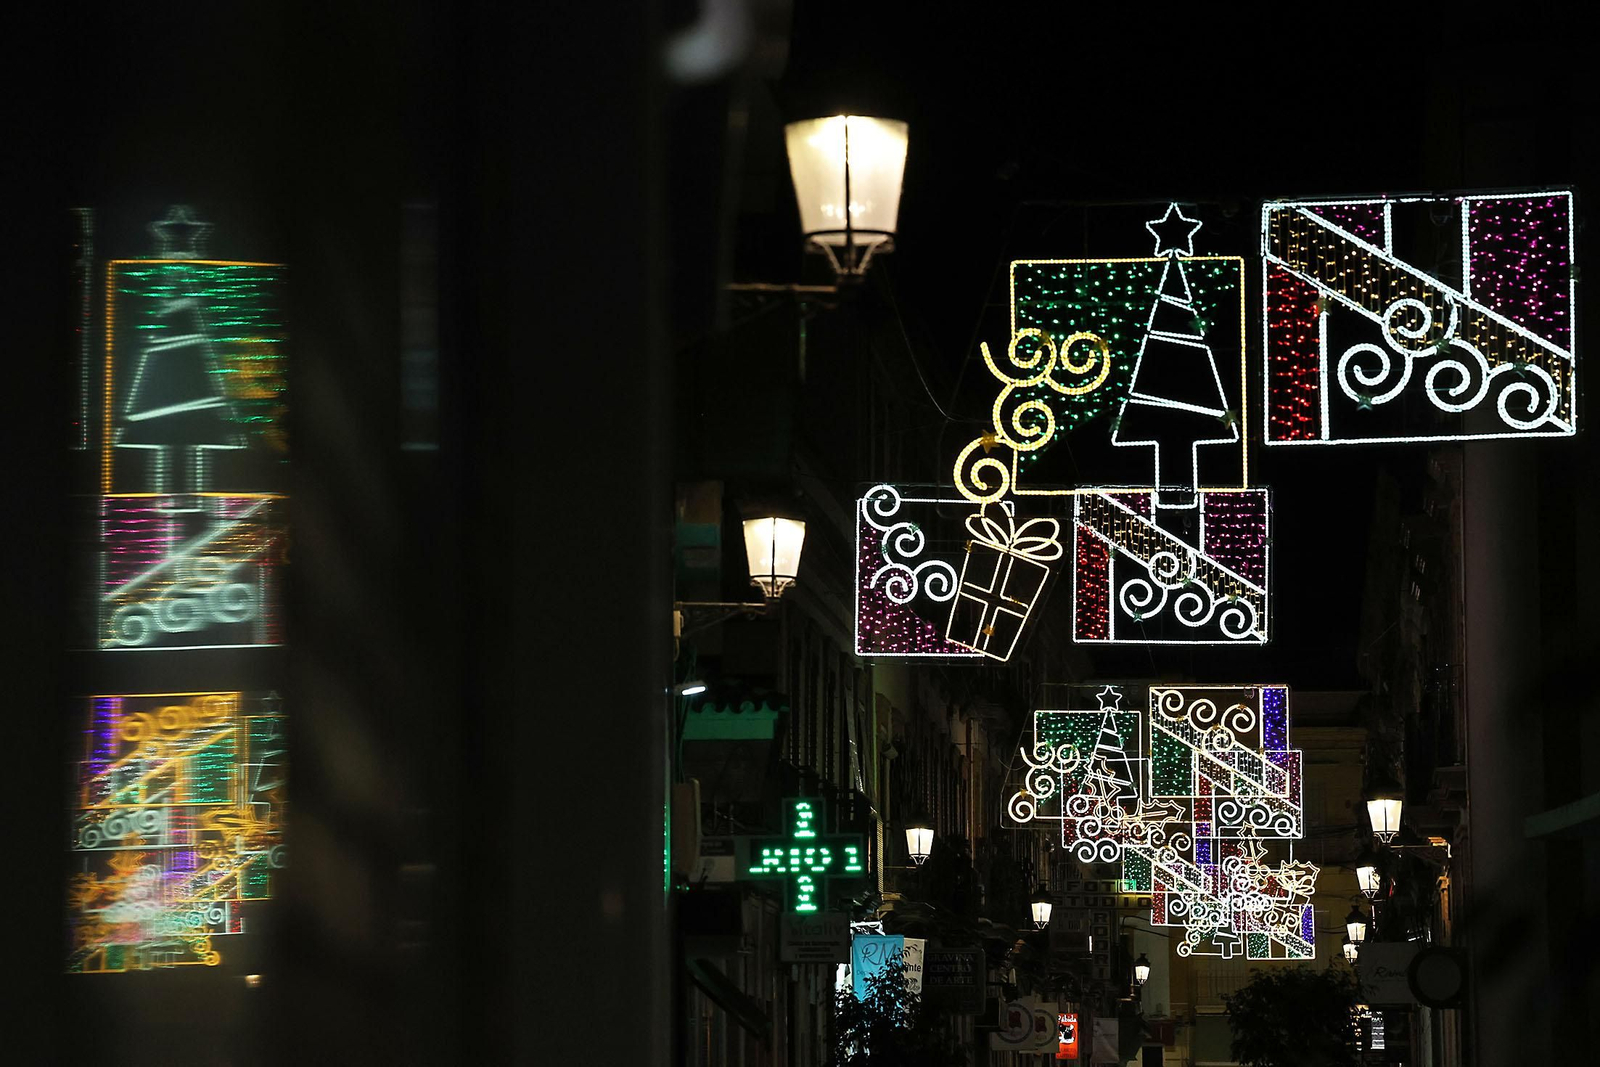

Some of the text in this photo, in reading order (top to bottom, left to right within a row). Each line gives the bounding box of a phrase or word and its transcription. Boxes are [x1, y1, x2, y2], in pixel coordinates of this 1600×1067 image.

[928, 952, 975, 963] GRAVINA
[929, 964, 973, 974] CENTRO
[929, 976, 974, 985] DE ARTE
